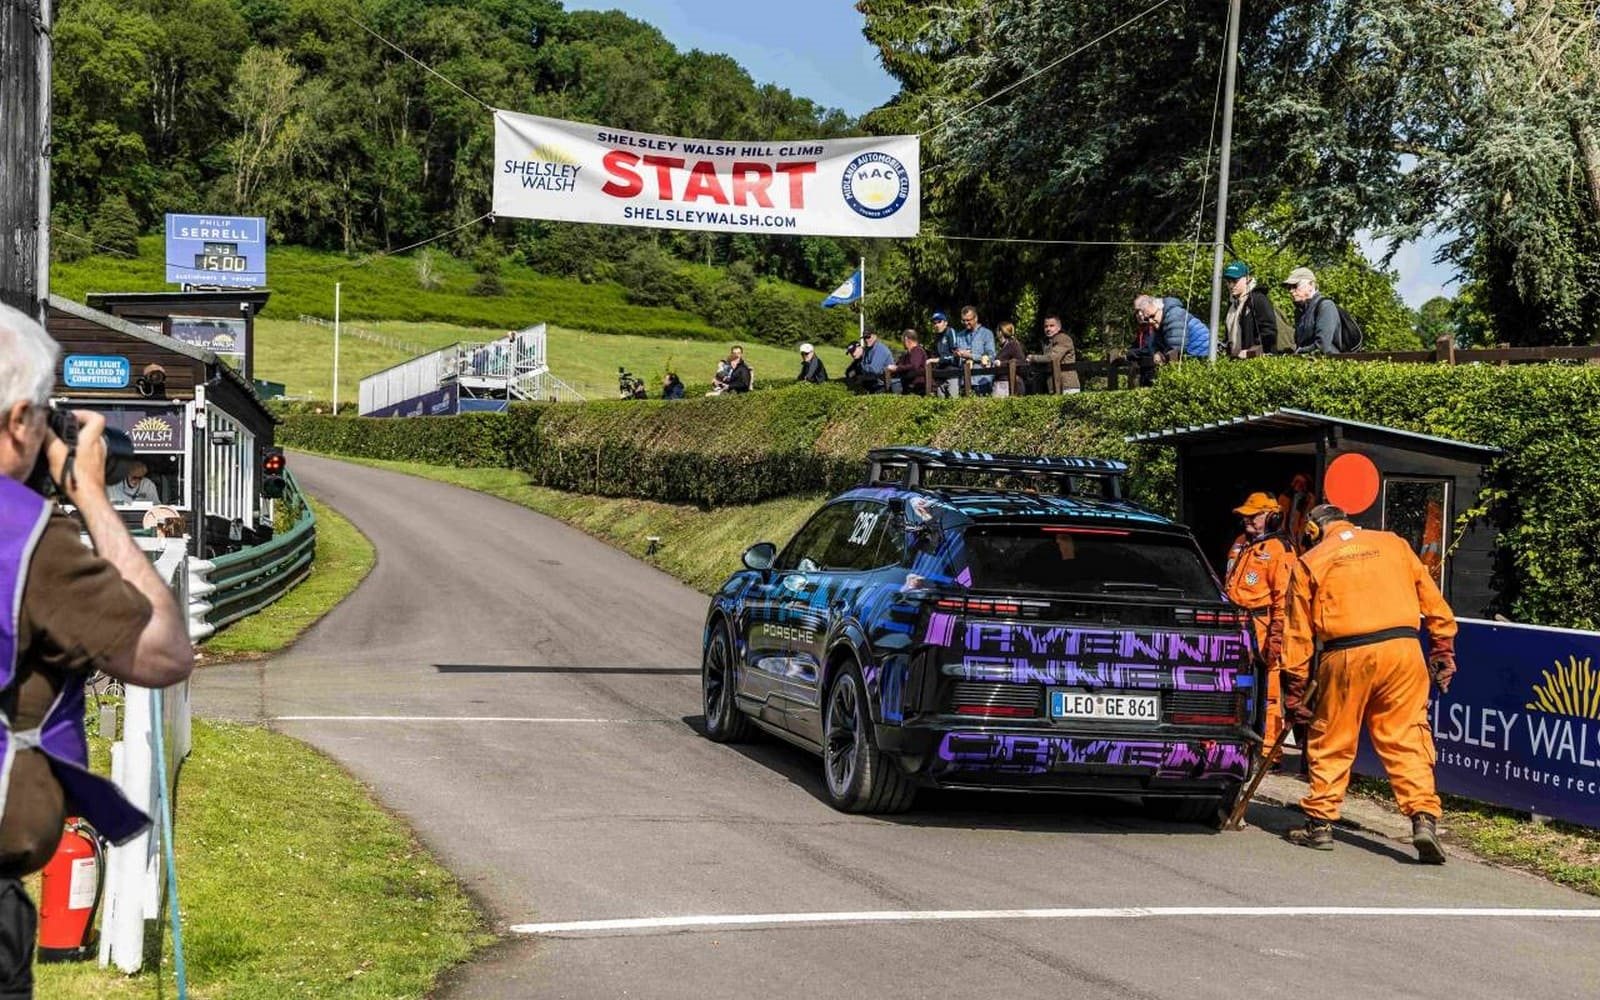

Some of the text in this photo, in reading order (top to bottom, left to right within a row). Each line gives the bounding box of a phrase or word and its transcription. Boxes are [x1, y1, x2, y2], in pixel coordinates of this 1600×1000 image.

[597, 131, 824, 157] SHELSLEY WALSH HILL CLIMB
[504, 160, 582, 178] SHELSLEY
[857, 168, 894, 181] MAC
[521, 175, 576, 192] WALSH
[601, 149, 817, 210] START
[200, 219, 231, 227] PHILIP
[623, 206, 797, 228] SHELSLEYWALSH.COM
[181, 227, 249, 240] SERRELL
[72, 359, 122, 368] AMBER LIGHT
[87, 367, 114, 376] CLOSED
[116, 368, 126, 377] TO
[72, 375, 122, 384] COMPETITORS
[131, 430, 173, 441] WALSH
[762, 623, 814, 644] PORSCHE
[1064, 696, 1156, 718] LEO GE 861
[1427, 699, 1600, 769] LSLEY WAL
[1567, 777, 1600, 796] rec
